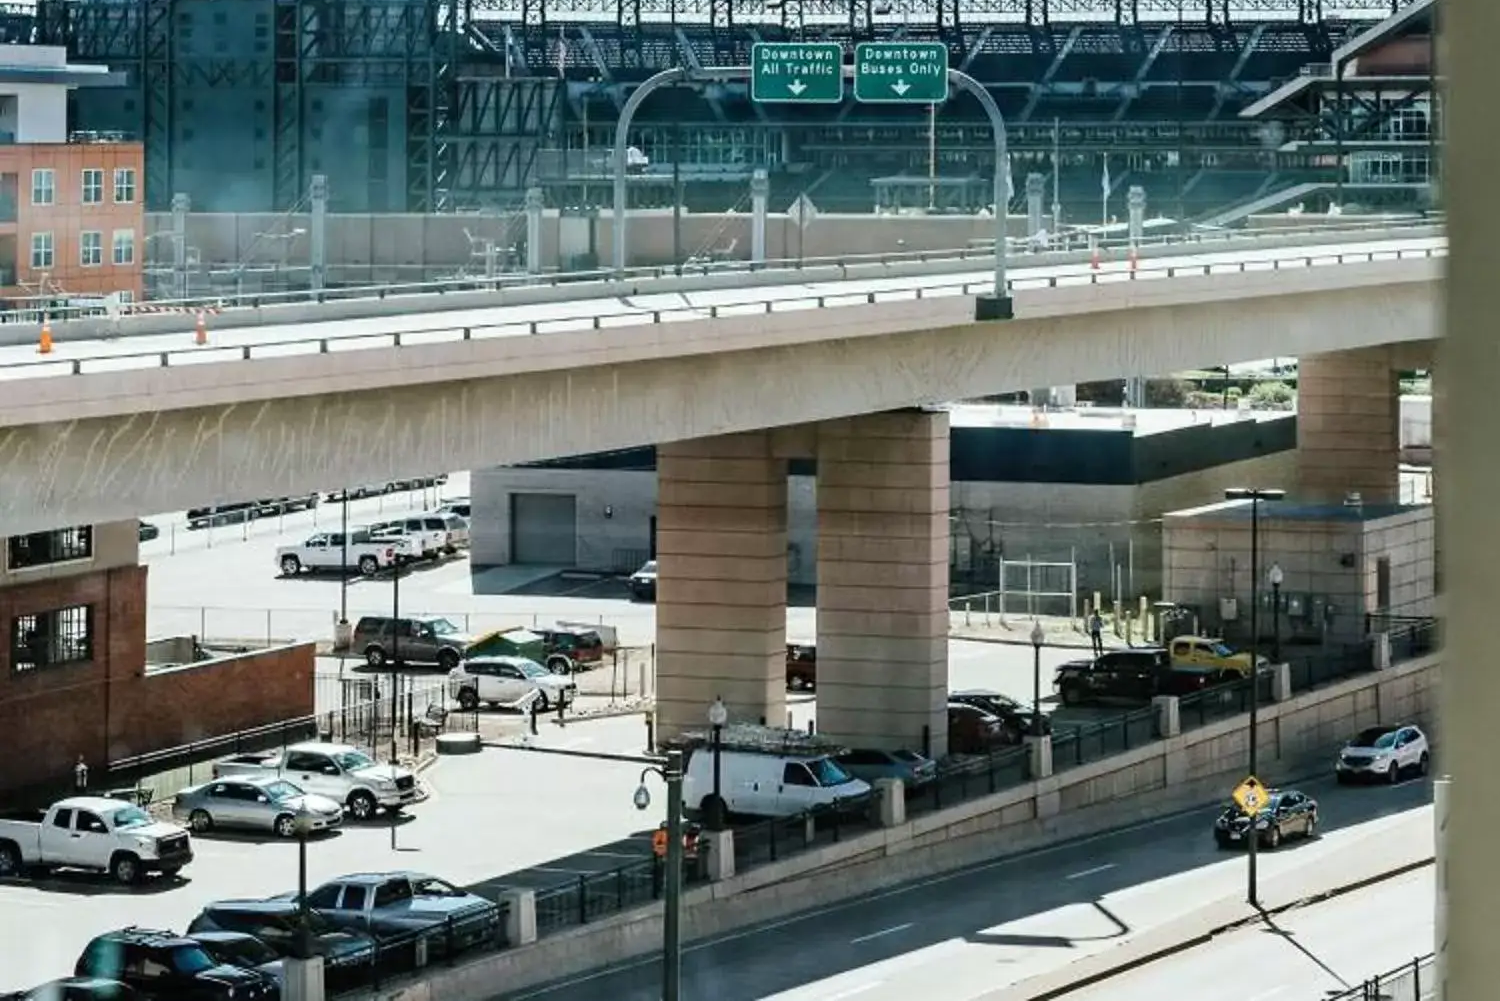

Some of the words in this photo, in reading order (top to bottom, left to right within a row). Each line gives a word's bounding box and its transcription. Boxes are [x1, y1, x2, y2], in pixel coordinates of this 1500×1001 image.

[761, 48, 833, 60] Downtown
[865, 48, 937, 60] Downtown
[761, 62, 779, 75] All
[786, 62, 833, 75] Traffic
[861, 62, 903, 74] Buses
[909, 62, 941, 76] Only
